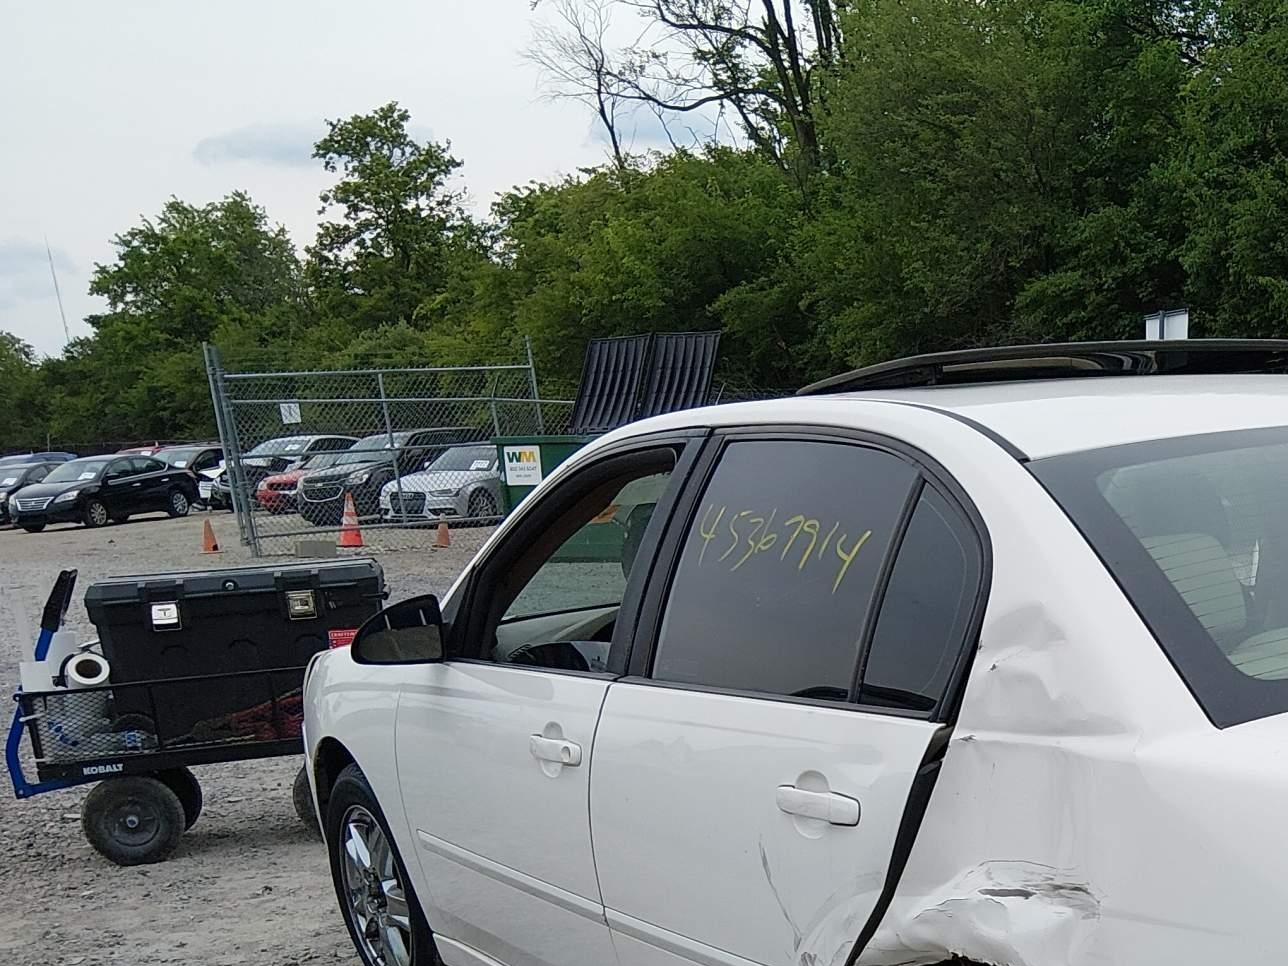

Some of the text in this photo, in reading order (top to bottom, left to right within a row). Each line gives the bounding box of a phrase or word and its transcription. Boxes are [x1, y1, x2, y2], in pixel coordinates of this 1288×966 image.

[506, 451, 537, 463] WM
[699, 504, 872, 595] 45367914
[82, 763, 124, 776] KOBALT
